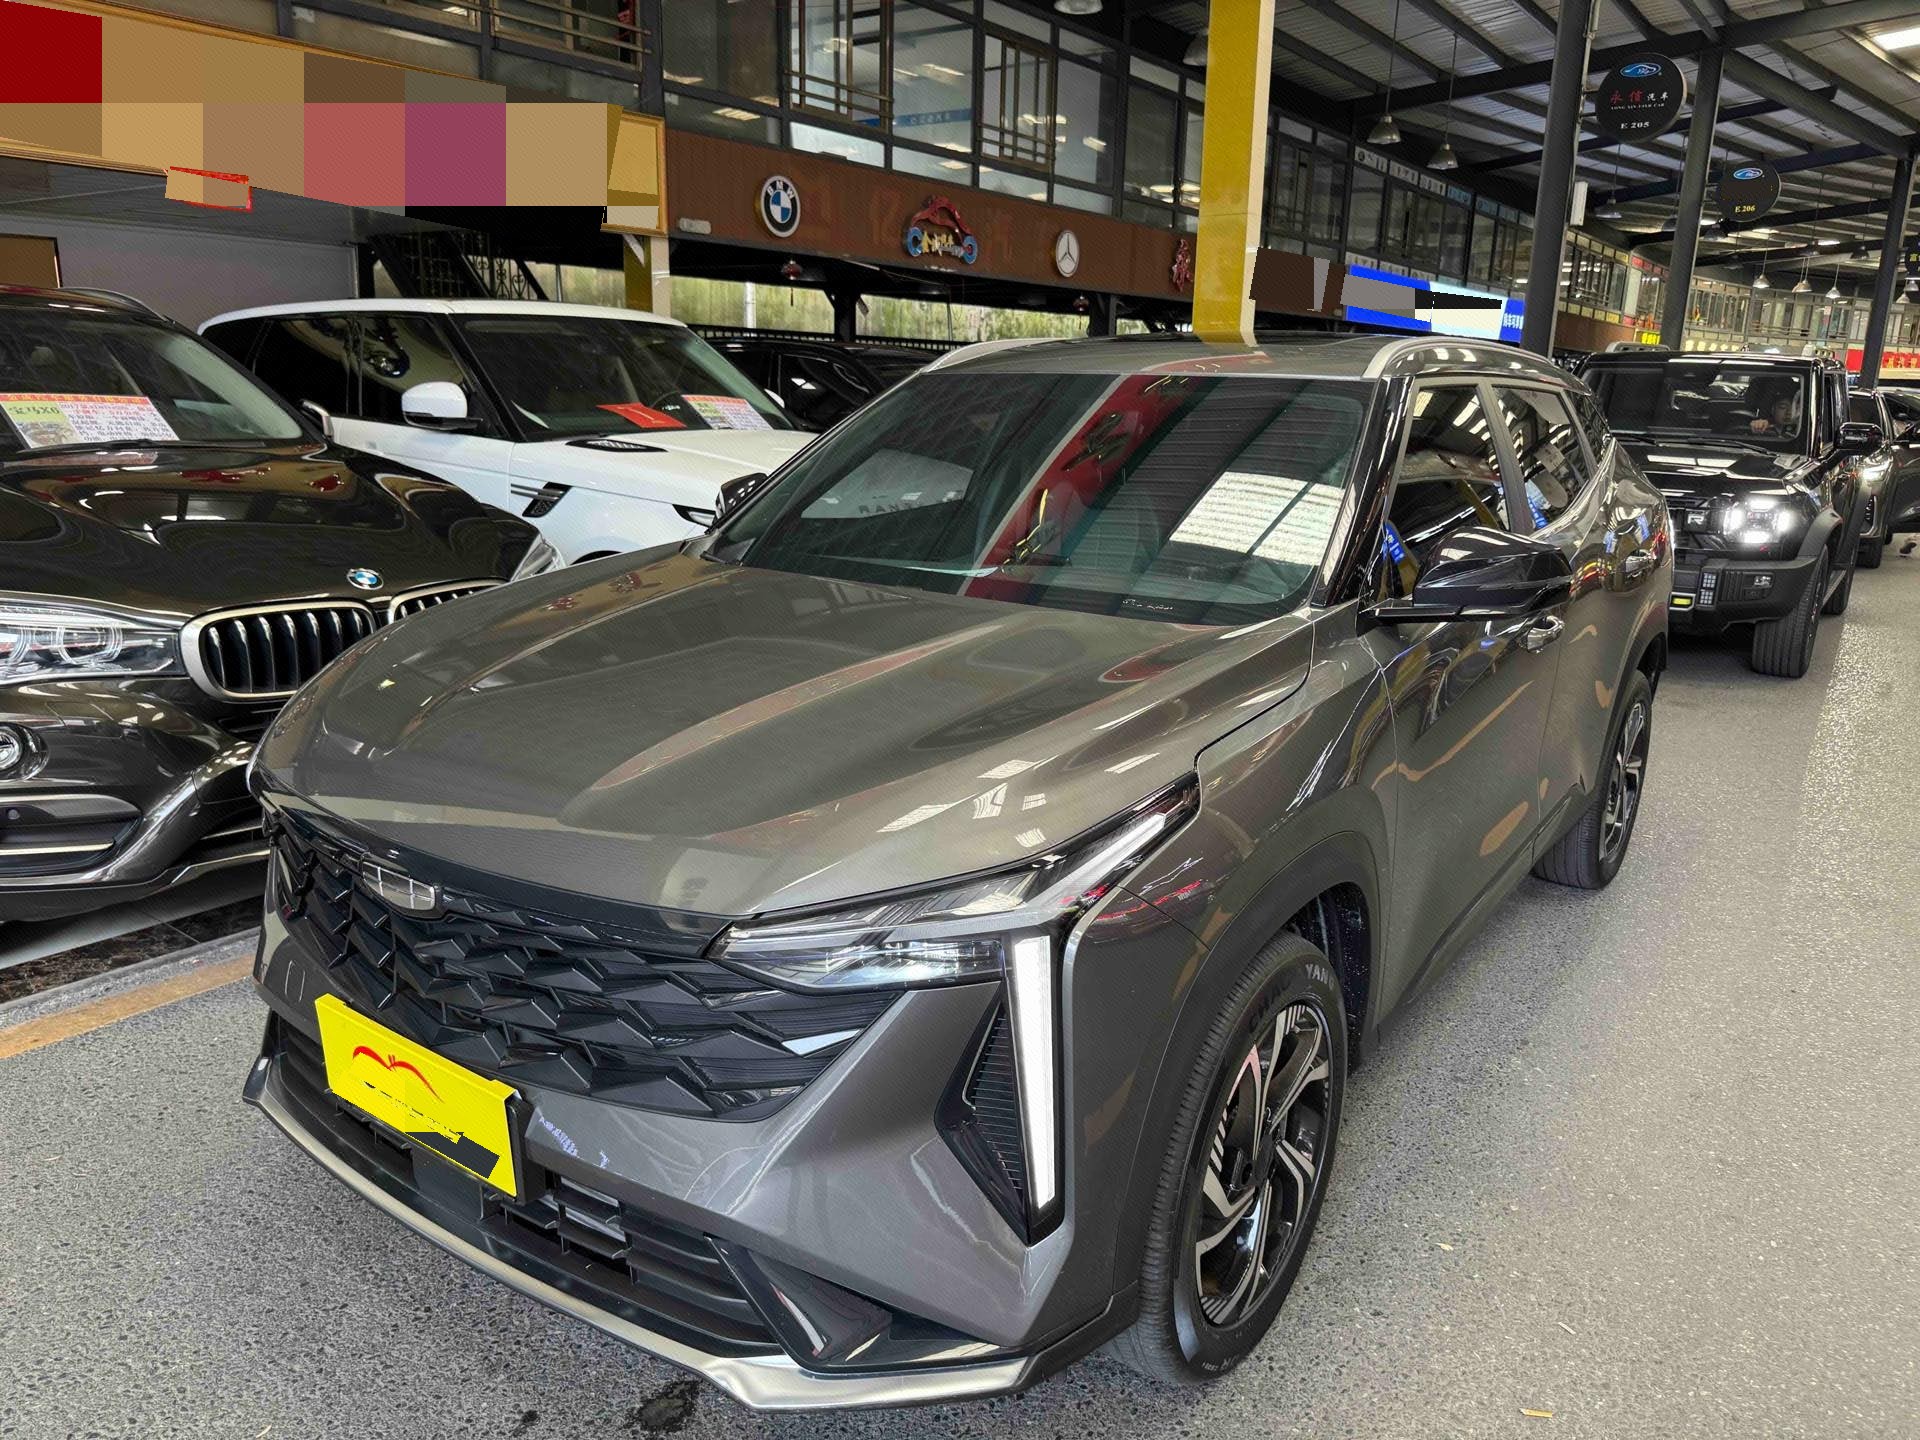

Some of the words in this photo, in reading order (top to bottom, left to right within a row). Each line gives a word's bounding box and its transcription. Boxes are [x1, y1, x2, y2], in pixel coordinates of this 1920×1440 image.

[1630, 121, 1650, 129] 205
[766, 180, 795, 199] BMW
[1741, 204, 1757, 213] 206
